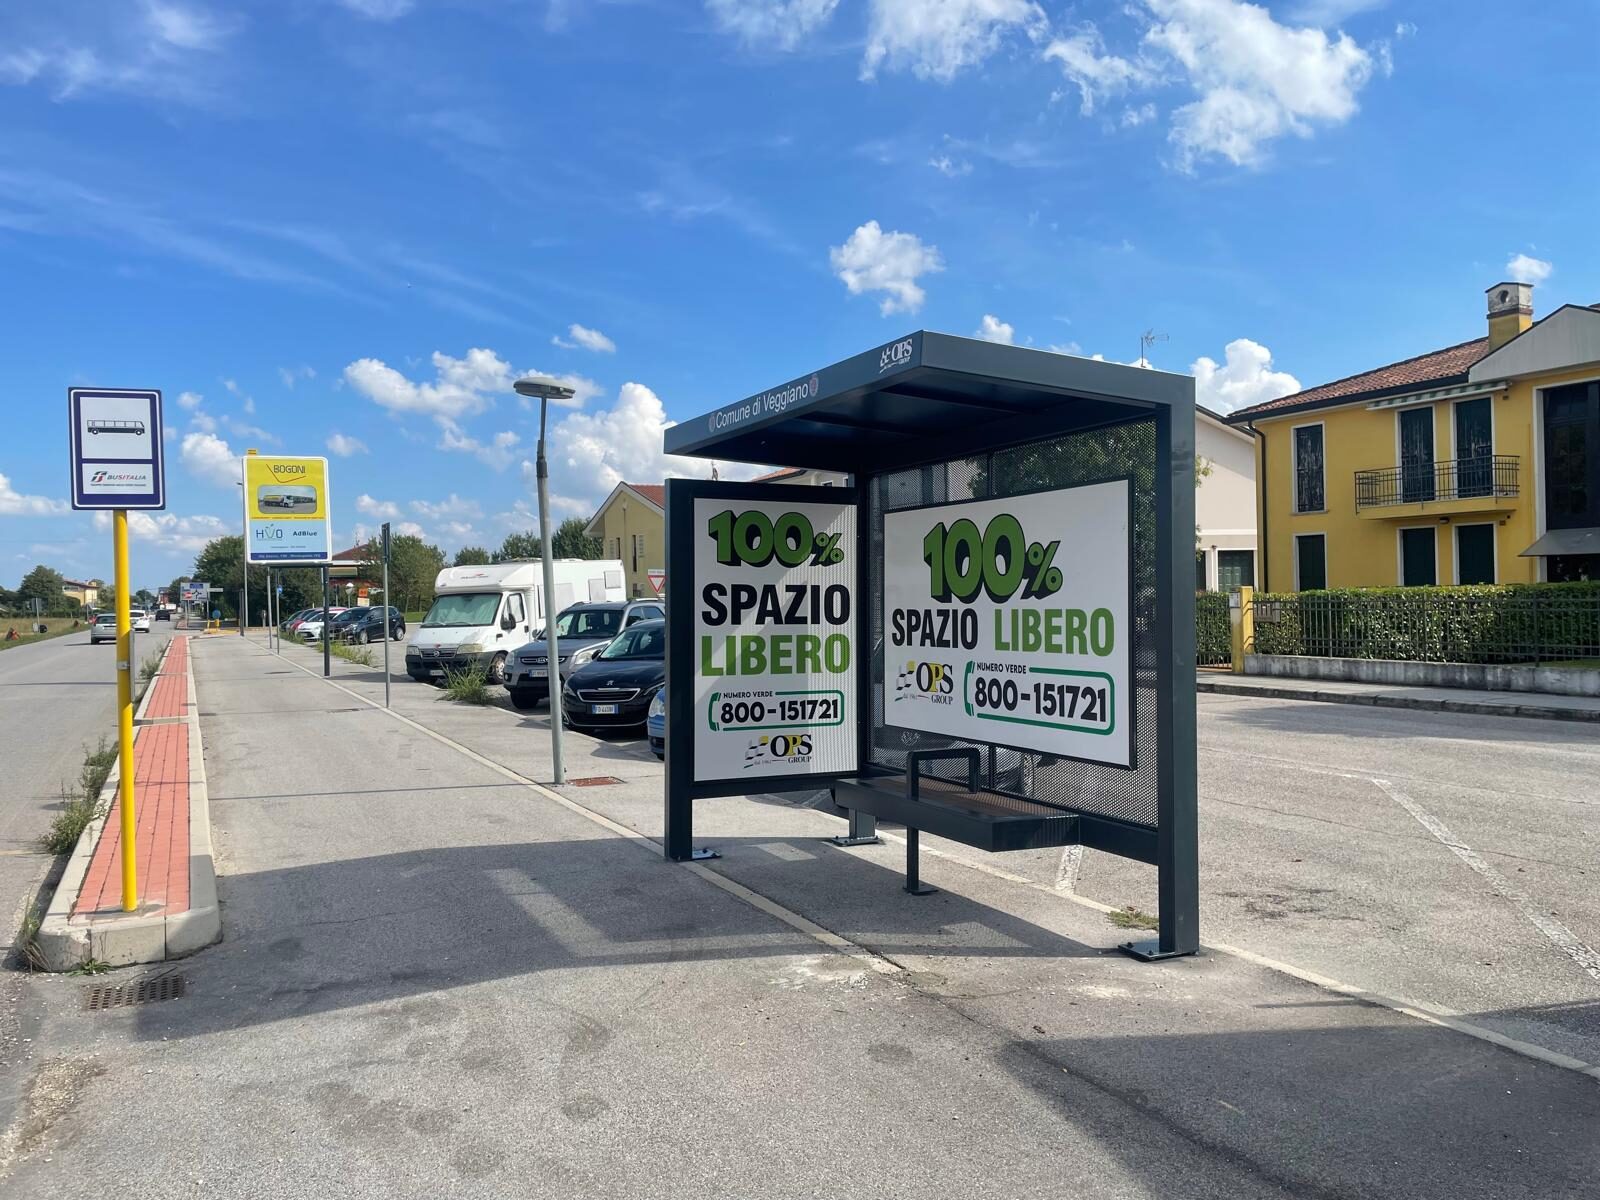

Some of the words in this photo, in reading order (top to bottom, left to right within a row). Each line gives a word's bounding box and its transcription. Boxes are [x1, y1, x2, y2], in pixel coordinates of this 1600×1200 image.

[891, 338, 913, 361] OPS
[716, 404, 750, 429] Comune
[752, 397, 761, 416] di
[763, 383, 809, 412] Veggiano
[273, 464, 306, 474] BOGONI
[256, 527, 283, 539] HVO
[708, 510, 844, 568] 100%
[924, 513, 1063, 604] 100%
[701, 583, 850, 626] SPAZIO
[892, 608, 978, 650] SPAZIO
[994, 607, 1115, 657] LIBERO
[701, 633, 850, 677] LIBERO
[976, 662, 1004, 673] NUMERO
[1005, 664, 1027, 674] VERDE
[916, 662, 954, 694] OPS
[723, 691, 751, 699] NUMERO
[931, 694, 953, 705] GROUP
[975, 676, 1106, 722] 800-151721
[720, 699, 838, 723] 800-151721
[770, 734, 812, 757] OPS
